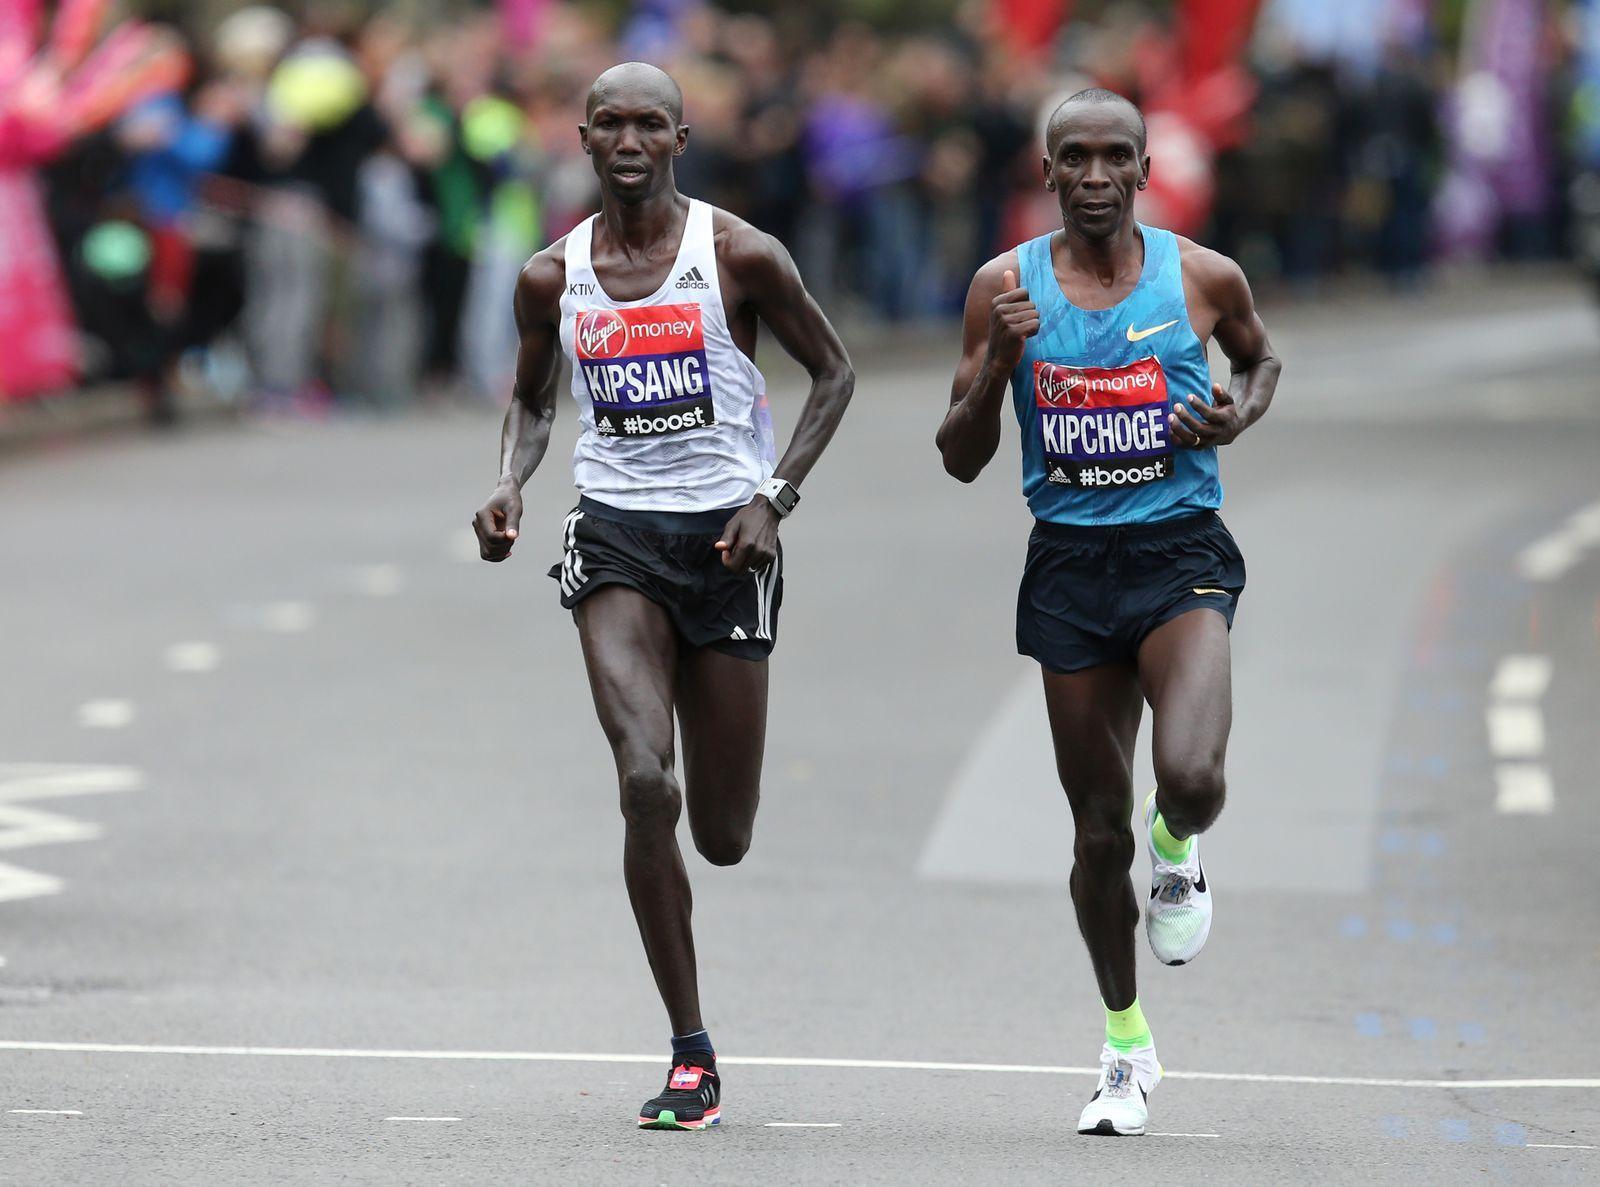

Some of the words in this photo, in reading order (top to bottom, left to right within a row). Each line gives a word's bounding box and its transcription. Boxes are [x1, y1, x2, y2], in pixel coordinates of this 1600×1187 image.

[567, 284, 596, 296] KTIV
[675, 280, 710, 290] adidas
[582, 313, 623, 354] Virgin
[631, 320, 695, 339] money
[584, 356, 704, 403] KIPSANG
[1042, 365, 1084, 404] Virgin
[1092, 371, 1158, 392] money
[623, 406, 705, 434] #boost
[1042, 408, 1166, 455] KIPCHOGE
[1079, 461, 1164, 486] #boost
